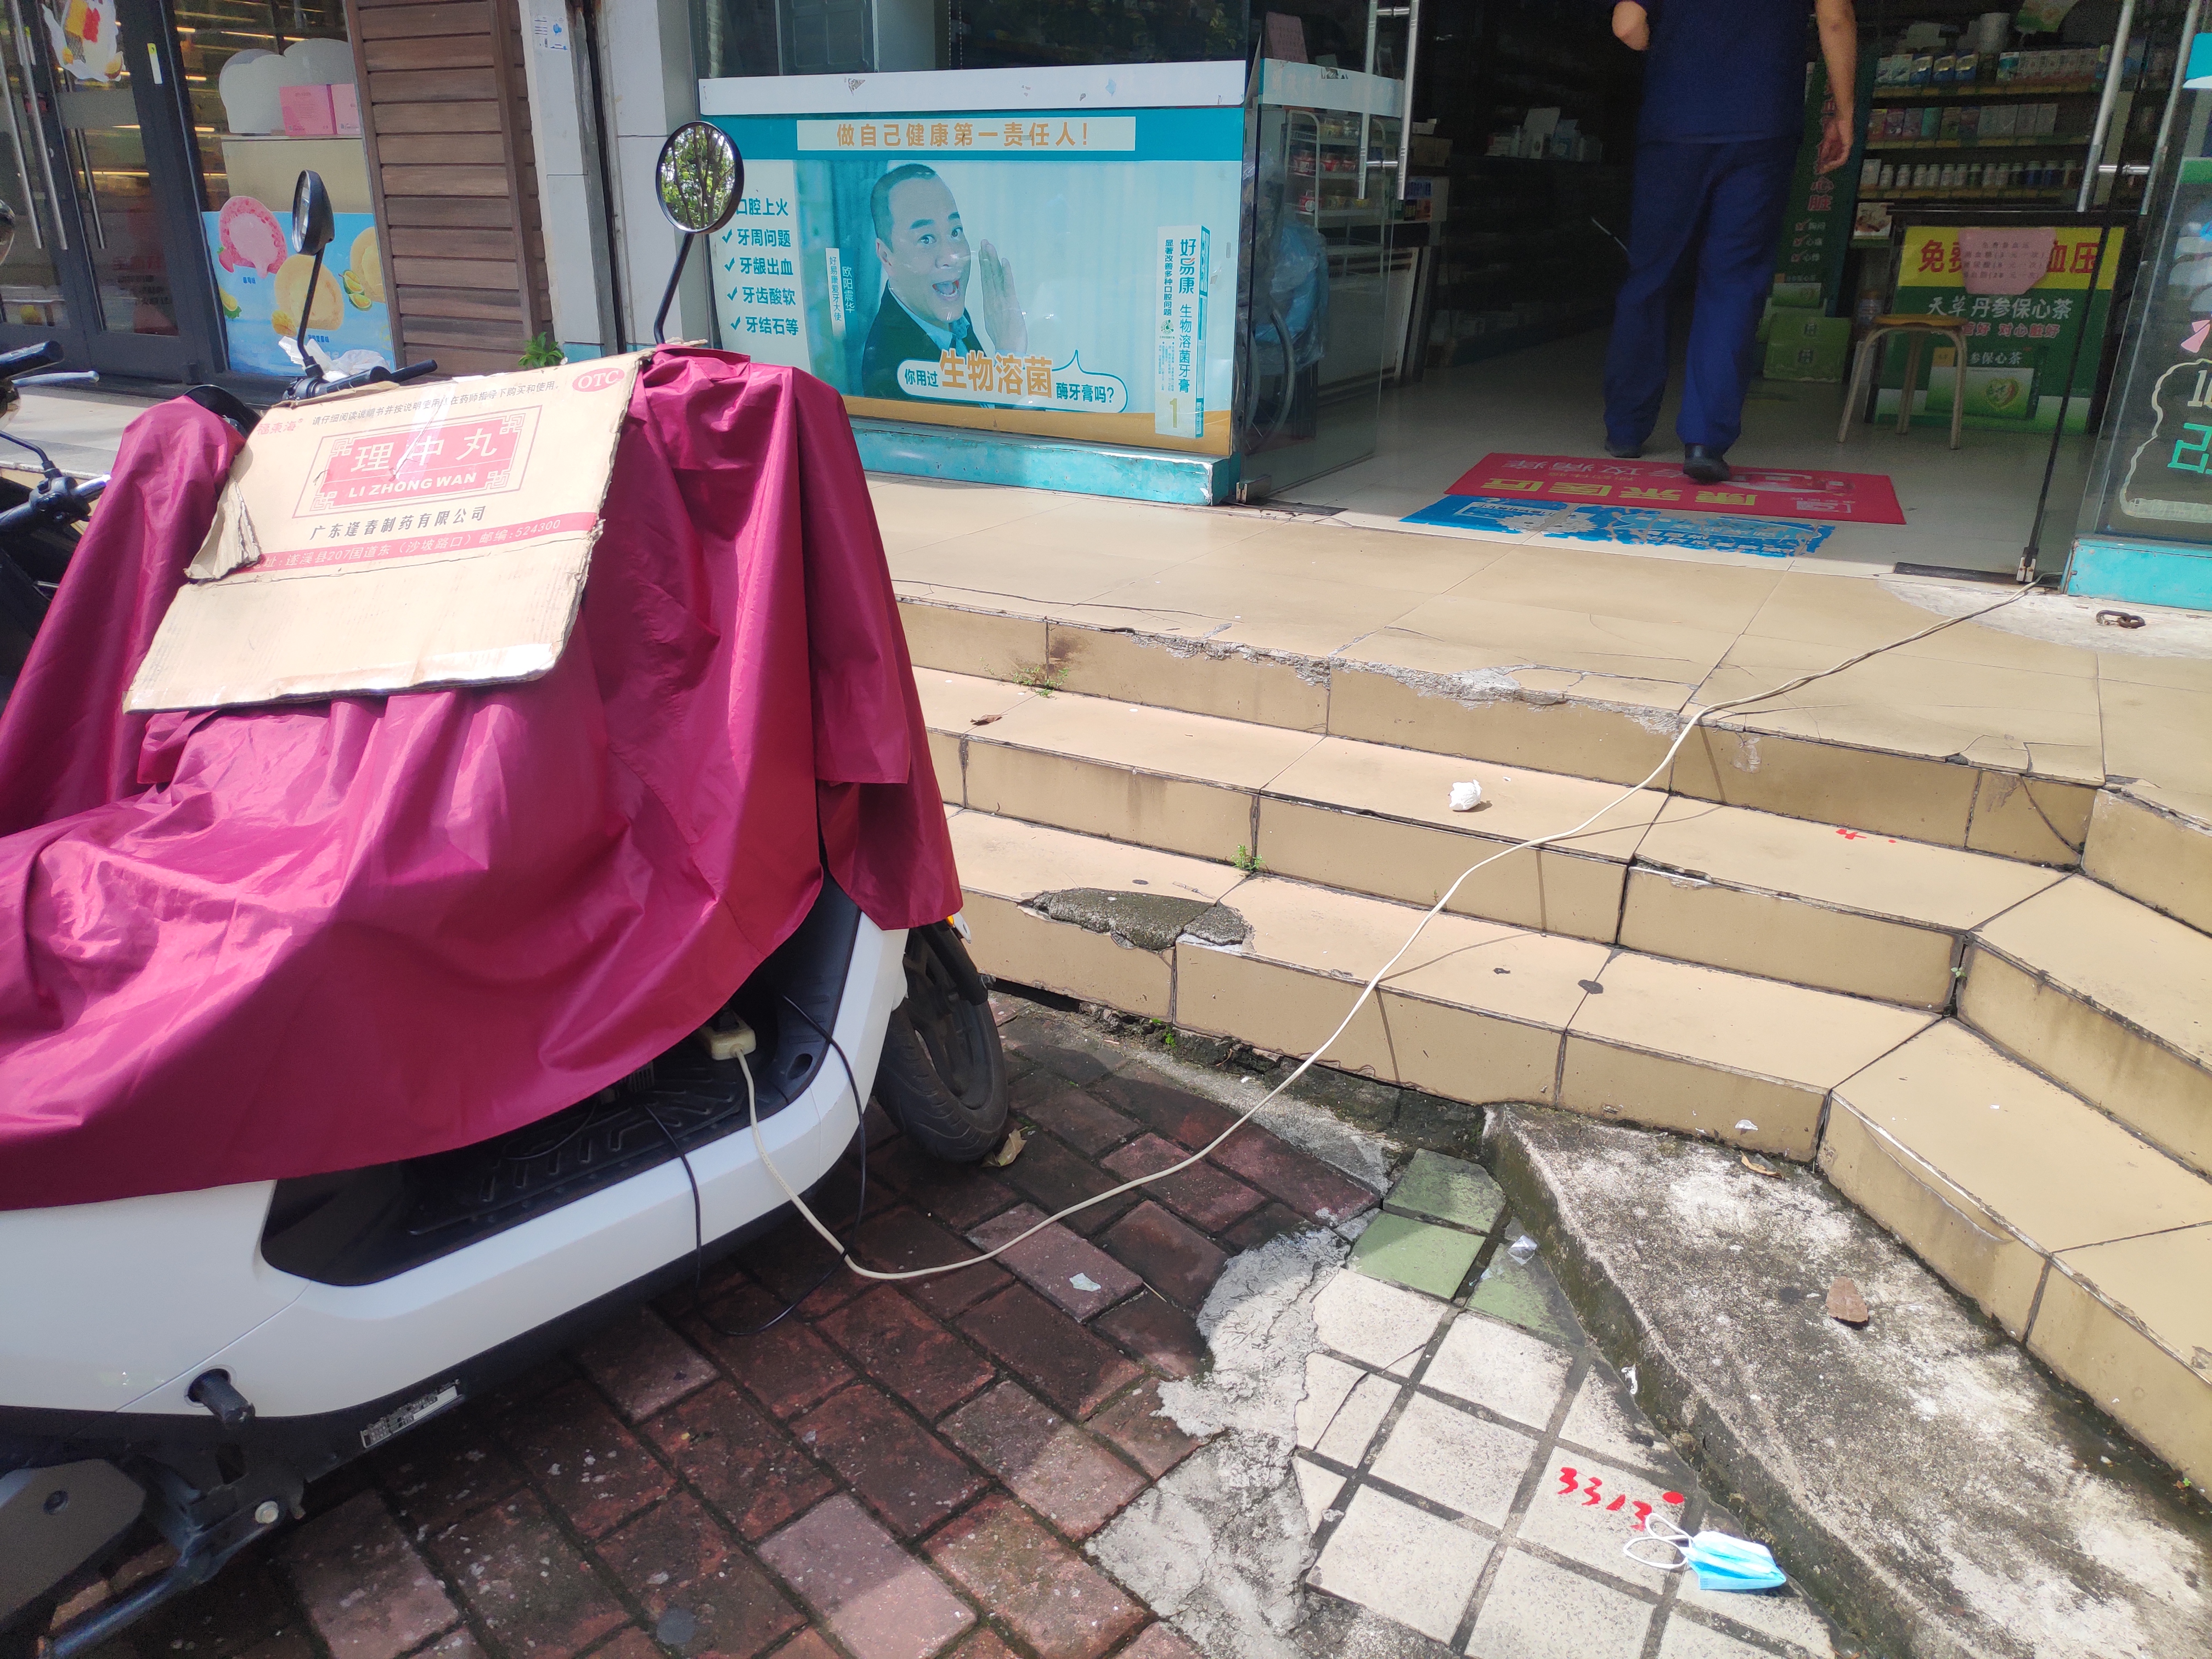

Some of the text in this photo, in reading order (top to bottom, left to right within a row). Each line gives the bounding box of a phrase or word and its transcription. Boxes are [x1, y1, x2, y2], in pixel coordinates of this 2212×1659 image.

[837, 121, 1087, 147] 做自己健康第一责任人!
[736, 198, 788, 216] 口腔上火
[737, 228, 791, 247] 牙周问题
[740, 257, 793, 275] 牙龈出血
[1163, 239, 1173, 316] 显著改善多种口腔问题
[742, 286, 796, 306] 牙齿酸软
[830, 256, 842, 321] 好易康爱牙大使
[842, 266, 855, 314] 欧阳震华
[745, 316, 799, 335] 牙结石等
[1178, 239, 1196, 393] 好易康 生物溶菌牙膏
[1970, 351, 2023, 365] 参保心茶
[578, 370, 619, 390] OTC
[905, 348, 1115, 404] 你用过 生物溶菌 酶牙膏吗?
[1169, 398, 1177, 428] 1
[256, 420, 297, 436] 福東海
[350, 428, 498, 473] 理中丸
[348, 472, 477, 498] LI ZHONG WAN
[310, 505, 487, 540] 广东逢春制药有限公司
[479, 519, 561, 544] 邮编:524300
